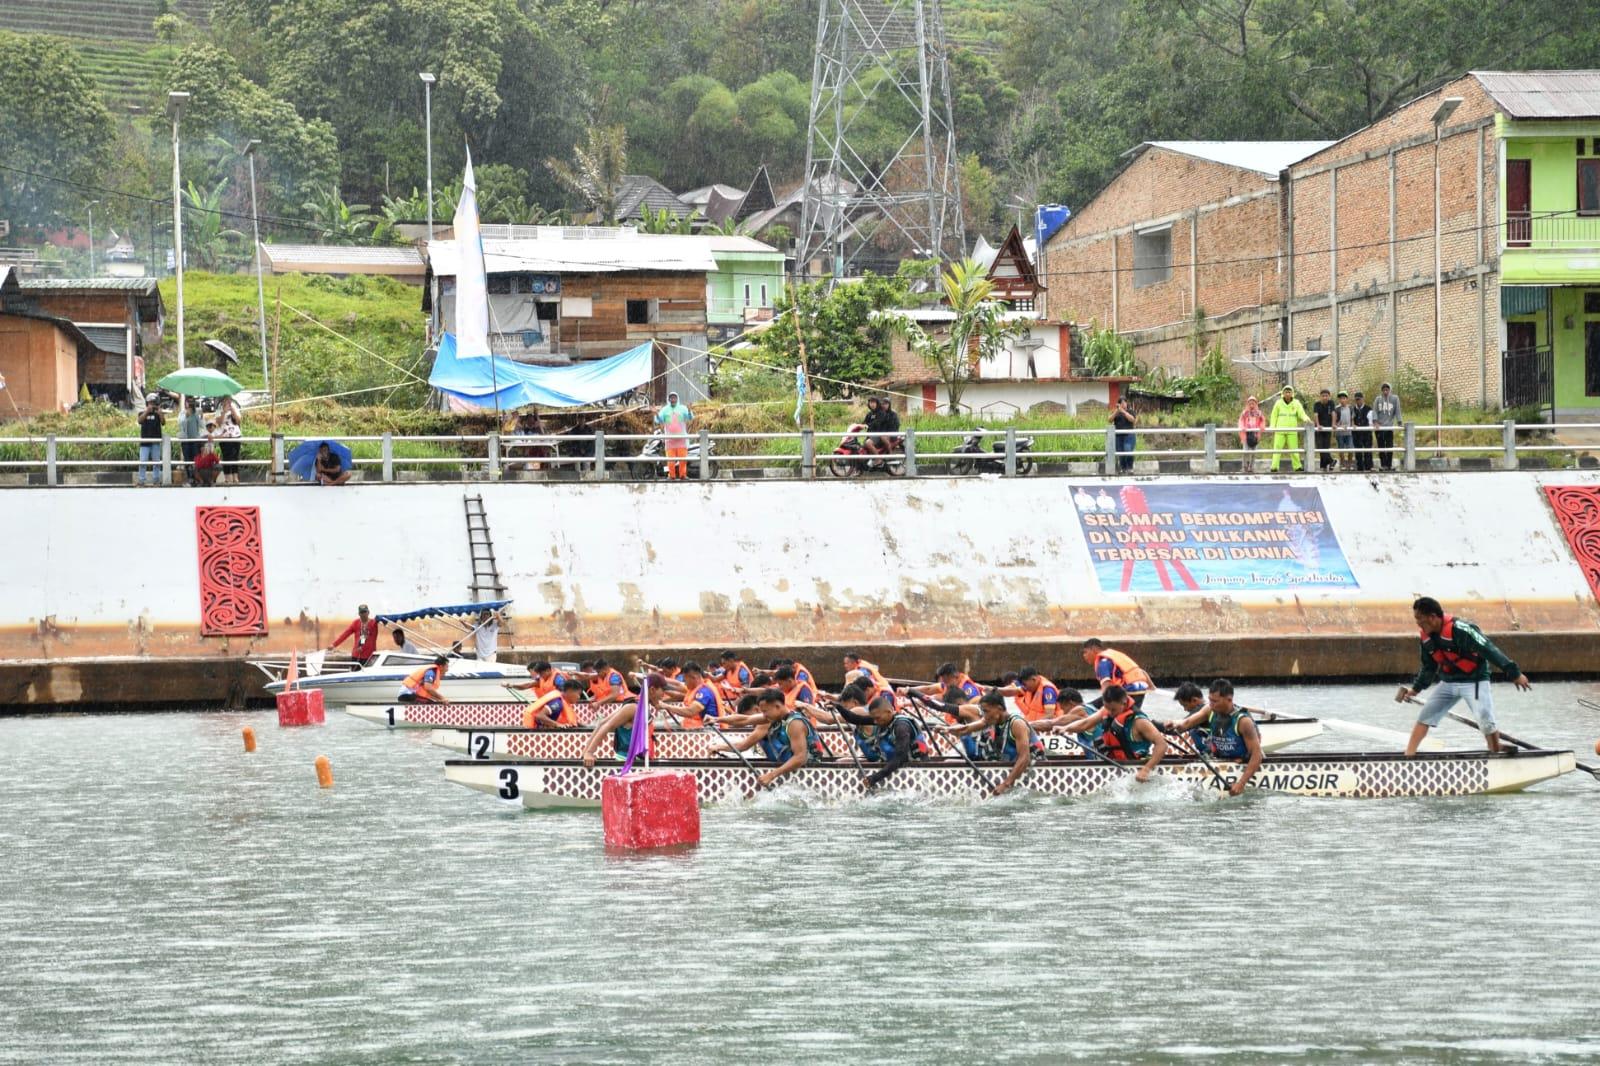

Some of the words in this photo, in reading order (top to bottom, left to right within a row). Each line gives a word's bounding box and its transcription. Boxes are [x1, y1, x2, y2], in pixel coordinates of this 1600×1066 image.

[1083, 513, 1173, 527] SELAMAT
[1180, 511, 1325, 526] BERKOMPETISI
[1088, 531, 1112, 544] DI
[1116, 530, 1186, 543] DANAU
[1190, 529, 1291, 542] VULKANIK
[1094, 547, 1200, 561] TERBESAR
[1203, 547, 1227, 560] DI
[1230, 546, 1297, 560] DUNIA
[386, 707, 396, 726] 1
[475, 736, 490, 759] 2
[499, 769, 519, 800] 3
